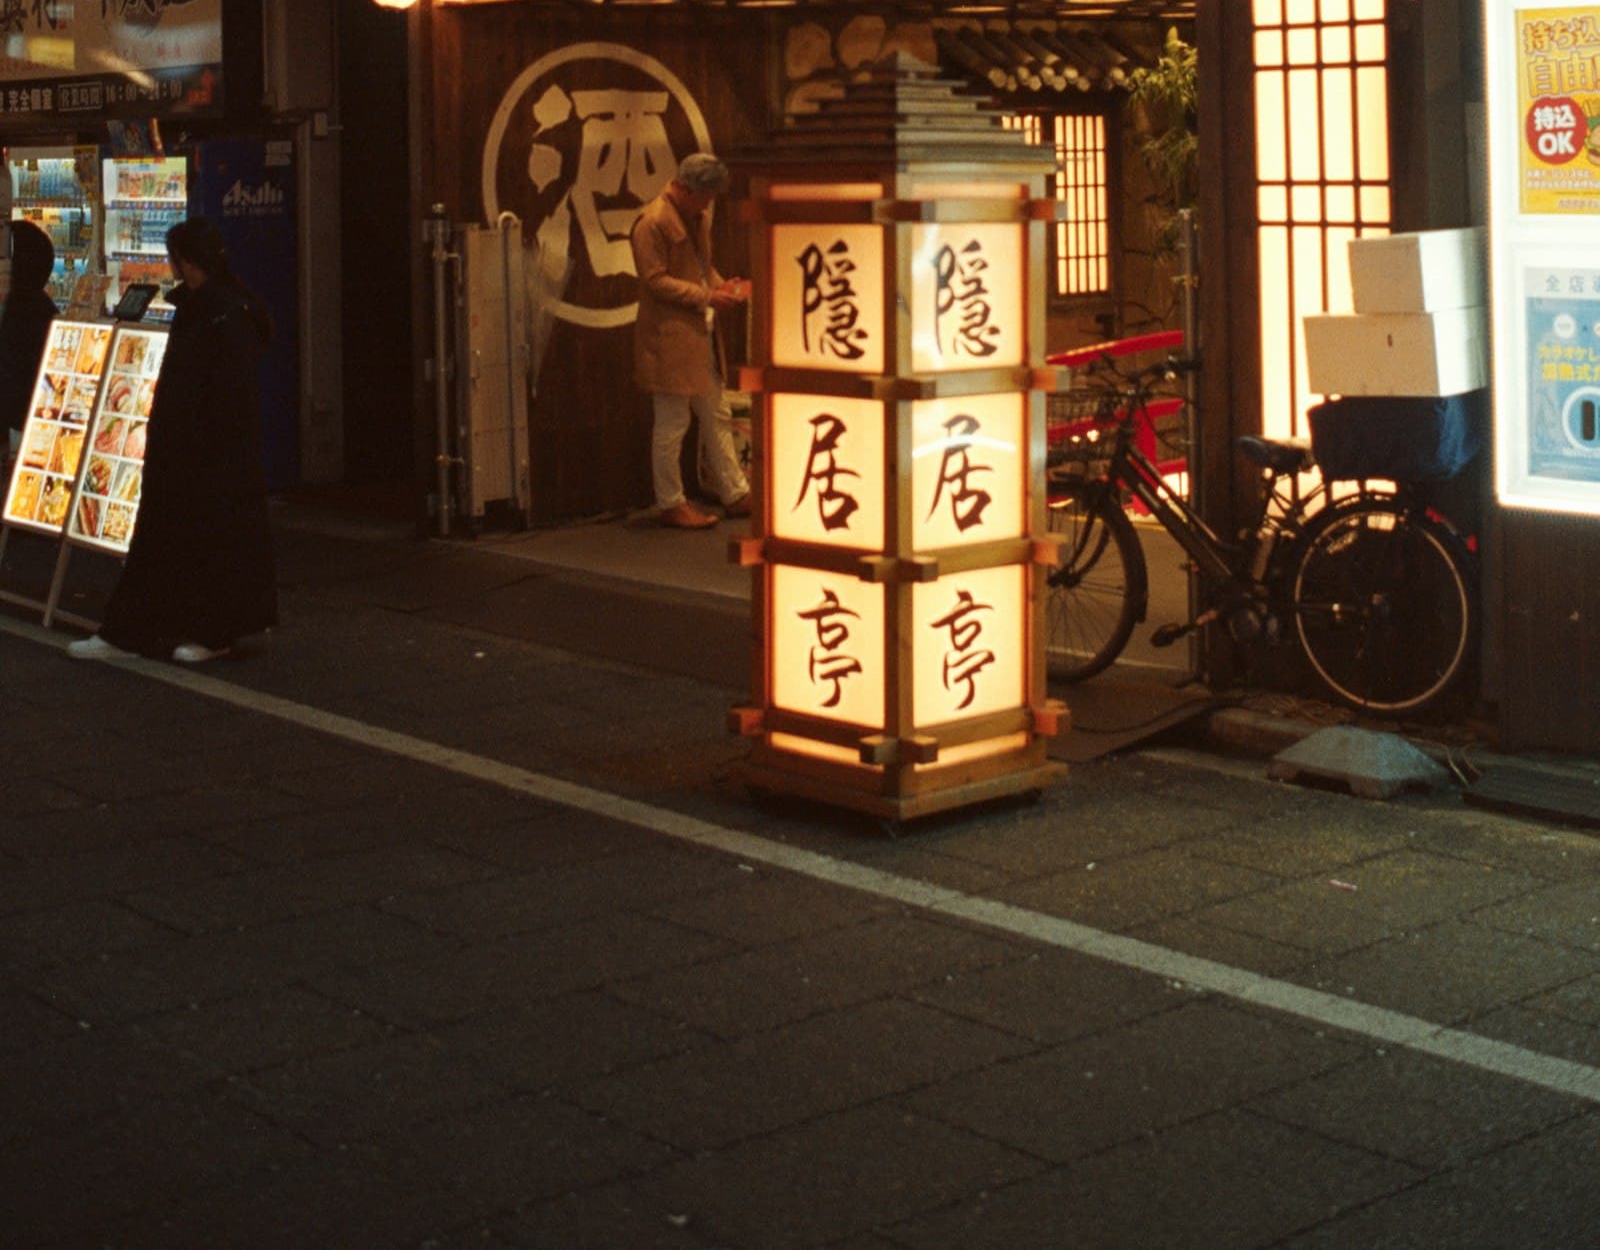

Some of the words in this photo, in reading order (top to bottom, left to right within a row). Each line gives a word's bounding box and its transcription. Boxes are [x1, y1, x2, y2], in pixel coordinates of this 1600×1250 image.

[1534, 104, 1577, 131] 持込
[1537, 131, 1576, 156] OK
[222, 179, 284, 206] Asahi
[791, 238, 871, 709] 隠居亭
[924, 238, 1001, 712] 隠居亭
